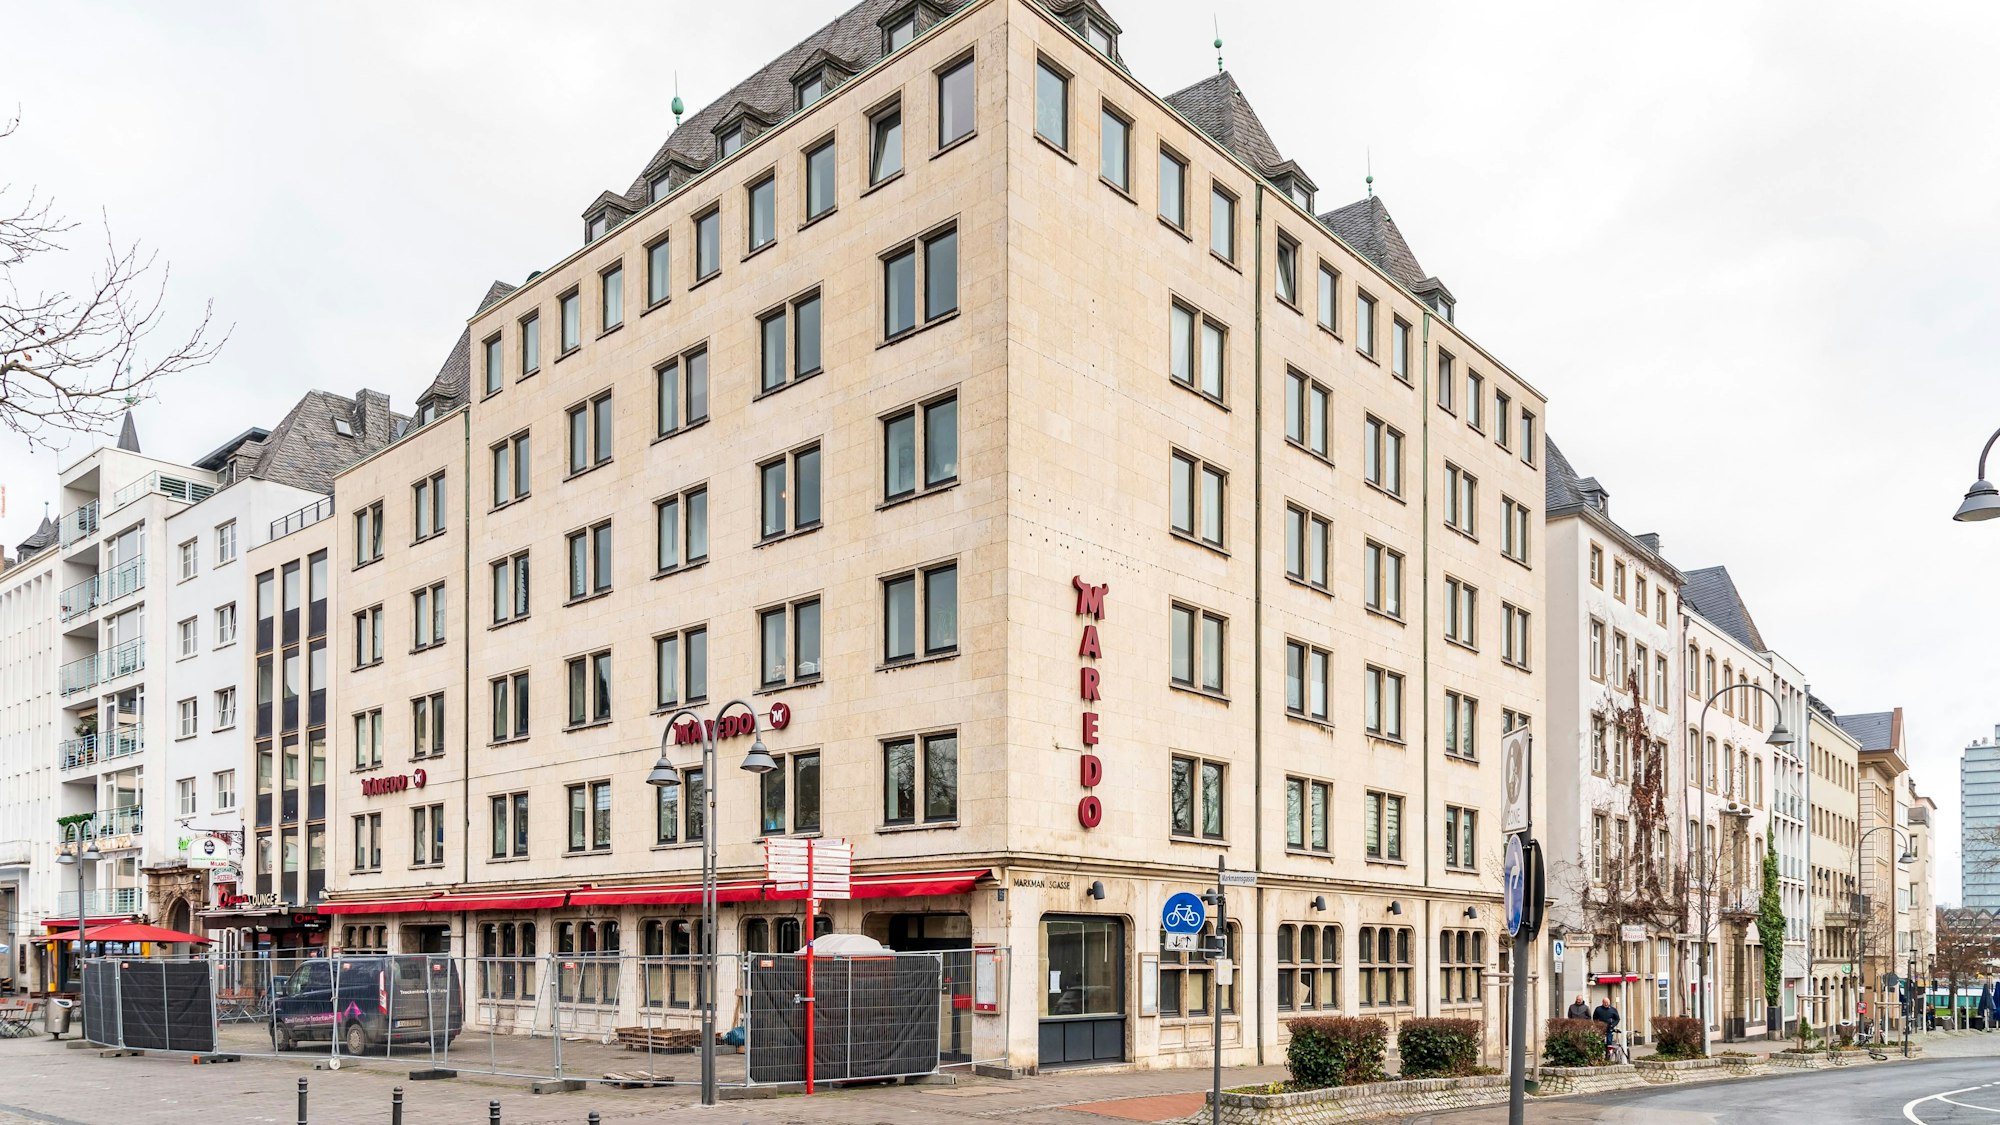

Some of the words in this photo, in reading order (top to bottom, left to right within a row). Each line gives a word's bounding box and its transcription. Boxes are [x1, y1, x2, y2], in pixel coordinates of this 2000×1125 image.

[1072, 575, 1110, 829] MAREDO
[673, 712, 756, 745] MAREDO
[361, 774, 408, 797] MAREDO
[1507, 807, 1521, 826] ZONE
[1013, 878, 1045, 888] MARKMAN
[1048, 880, 1071, 890] SGASSE
